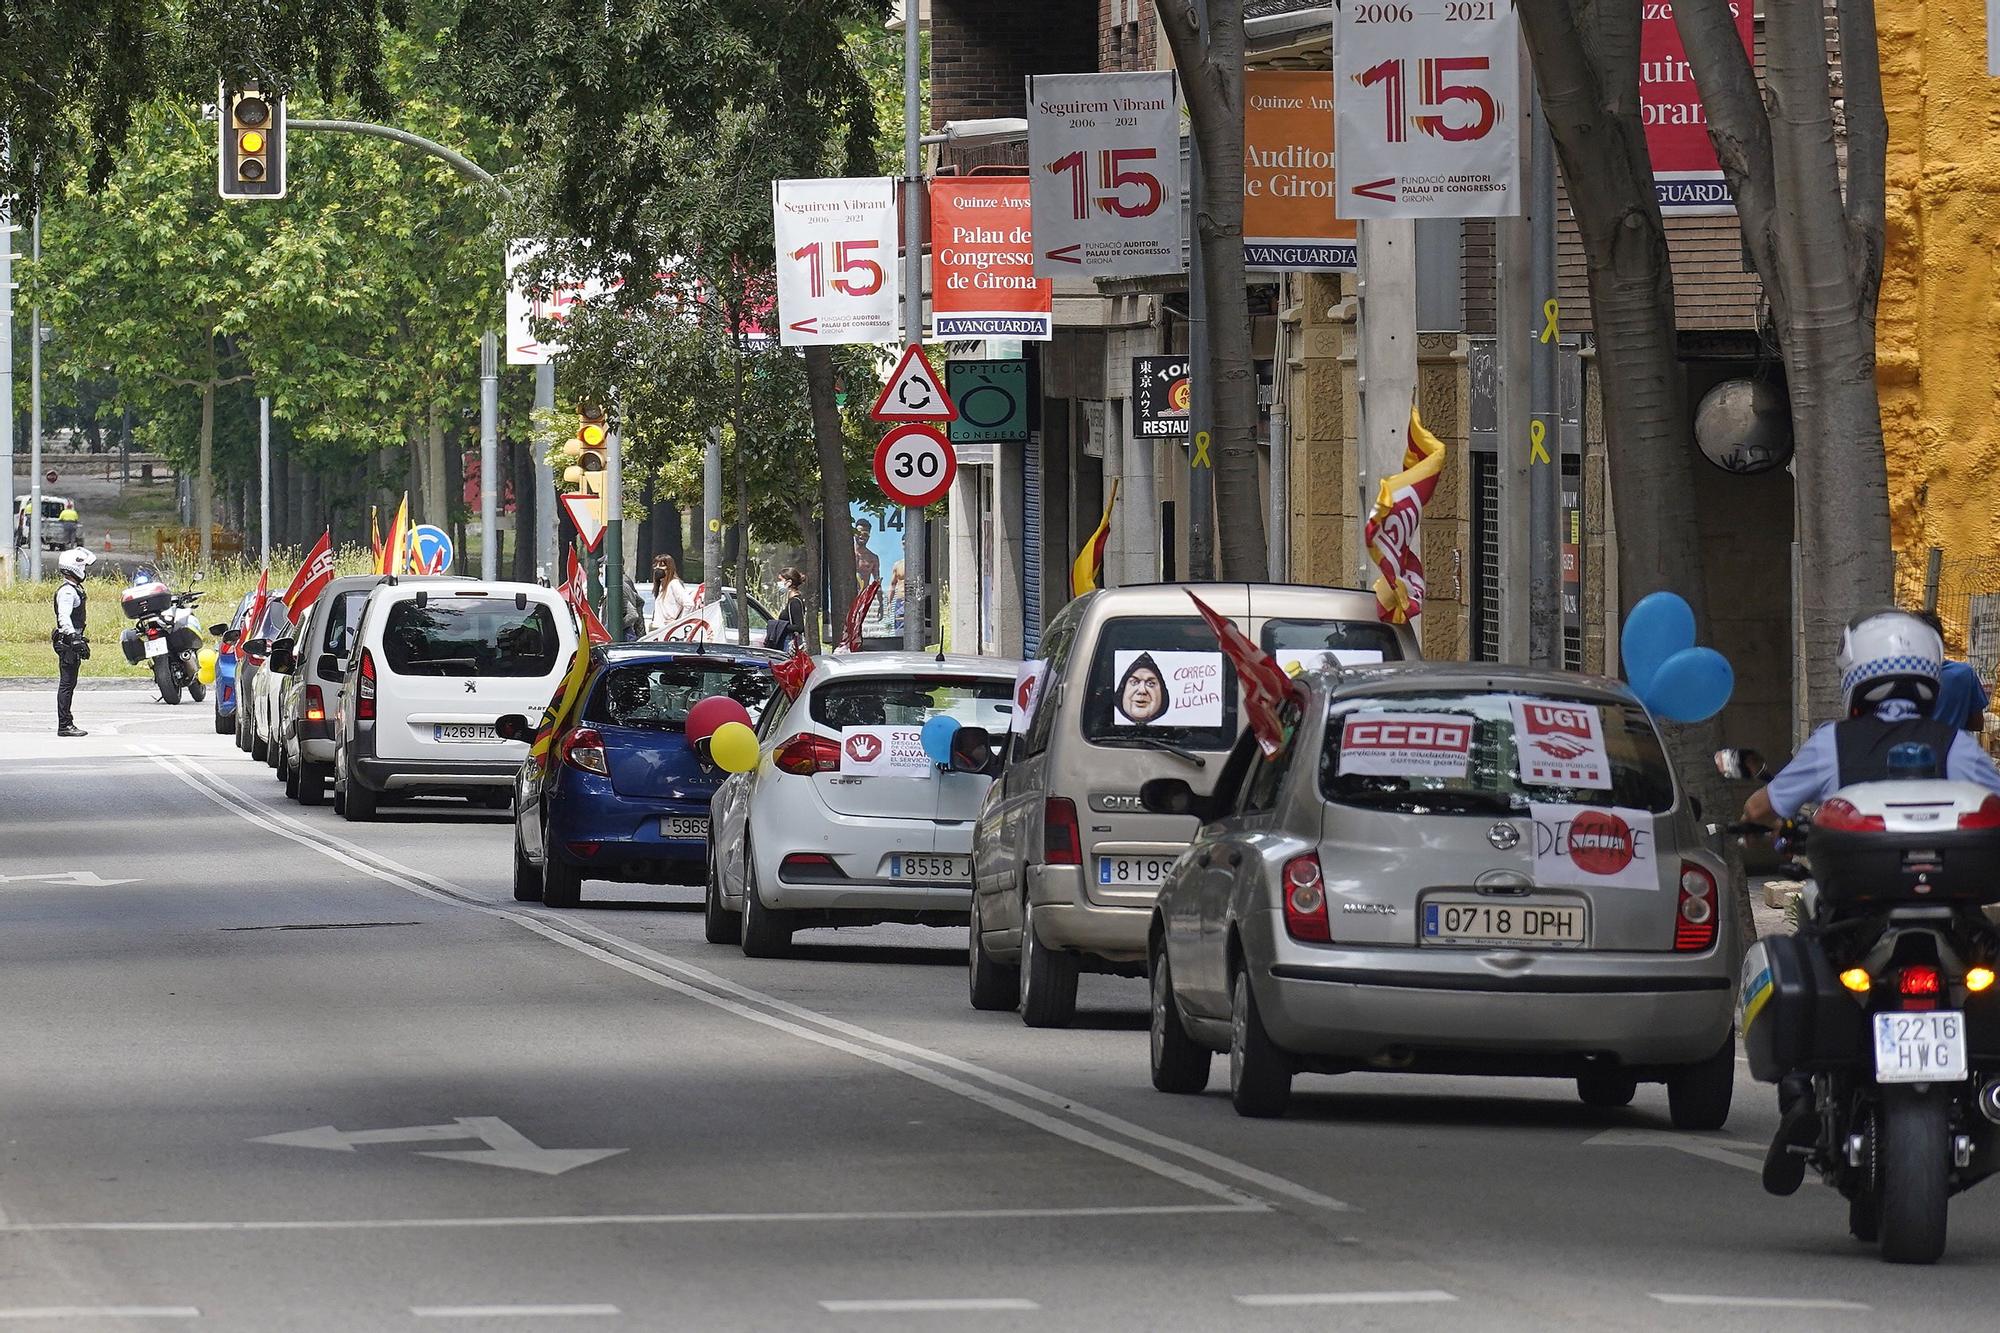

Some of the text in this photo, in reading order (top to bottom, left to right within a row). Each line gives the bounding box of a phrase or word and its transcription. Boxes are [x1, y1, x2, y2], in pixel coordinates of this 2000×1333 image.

[1355, 1, 1496, 24] 2006 2021
[1250, 95, 1303, 111] Quinze
[1350, 56, 1505, 143] 15
[1040, 99, 1166, 117] Seguirem Vibrant
[1069, 117, 1138, 129] 2006 2021
[1043, 148, 1170, 220] 15
[1402, 174, 1491, 184] FUNDACIÓ AUDITORI
[1402, 184, 1507, 194] PALAU DE CONGRESSOS
[784, 200, 886, 214] Seguirem Vibrant
[953, 196, 1031, 210] Quinze Anys
[1402, 195, 1434, 203] GIRONA
[808, 214, 864, 225] 2006 2021
[953, 227, 1032, 244] Palau de
[1086, 241, 1122, 250] FUNDACIÓ
[1122, 248, 1171, 256] CONGRESSOS
[940, 248, 1034, 269] Congresso
[1086, 257, 1113, 265] GIRONA
[1250, 248, 1357, 264] VANGUARDIA
[787, 240, 889, 297] 15
[946, 272, 1037, 289] de Girona
[940, 321, 1044, 333] LA VANGUARDIA
[1140, 360, 1152, 417] 東京ハウス
[1143, 420, 1189, 434] RESTAU
[953, 431, 1027, 440] CONEJERO
[895, 452, 938, 478] 30
[1173, 665, 1217, 680] CORREOS
[1184, 680, 1204, 694] EN
[1175, 693, 1220, 709] LUCHA
[1534, 707, 1588, 730] UGT
[443, 727, 475, 738] 4269
[892, 732, 920, 741] STO
[1351, 725, 1464, 747] CCOO
[672, 819, 708, 834] 5969
[905, 858, 971, 876] 8558 J
[1445, 908, 1511, 933] 0718
[1523, 910, 1572, 936] DPH
[1897, 1017, 1956, 1041] 2216
[1899, 1044, 1948, 1070] HWG
